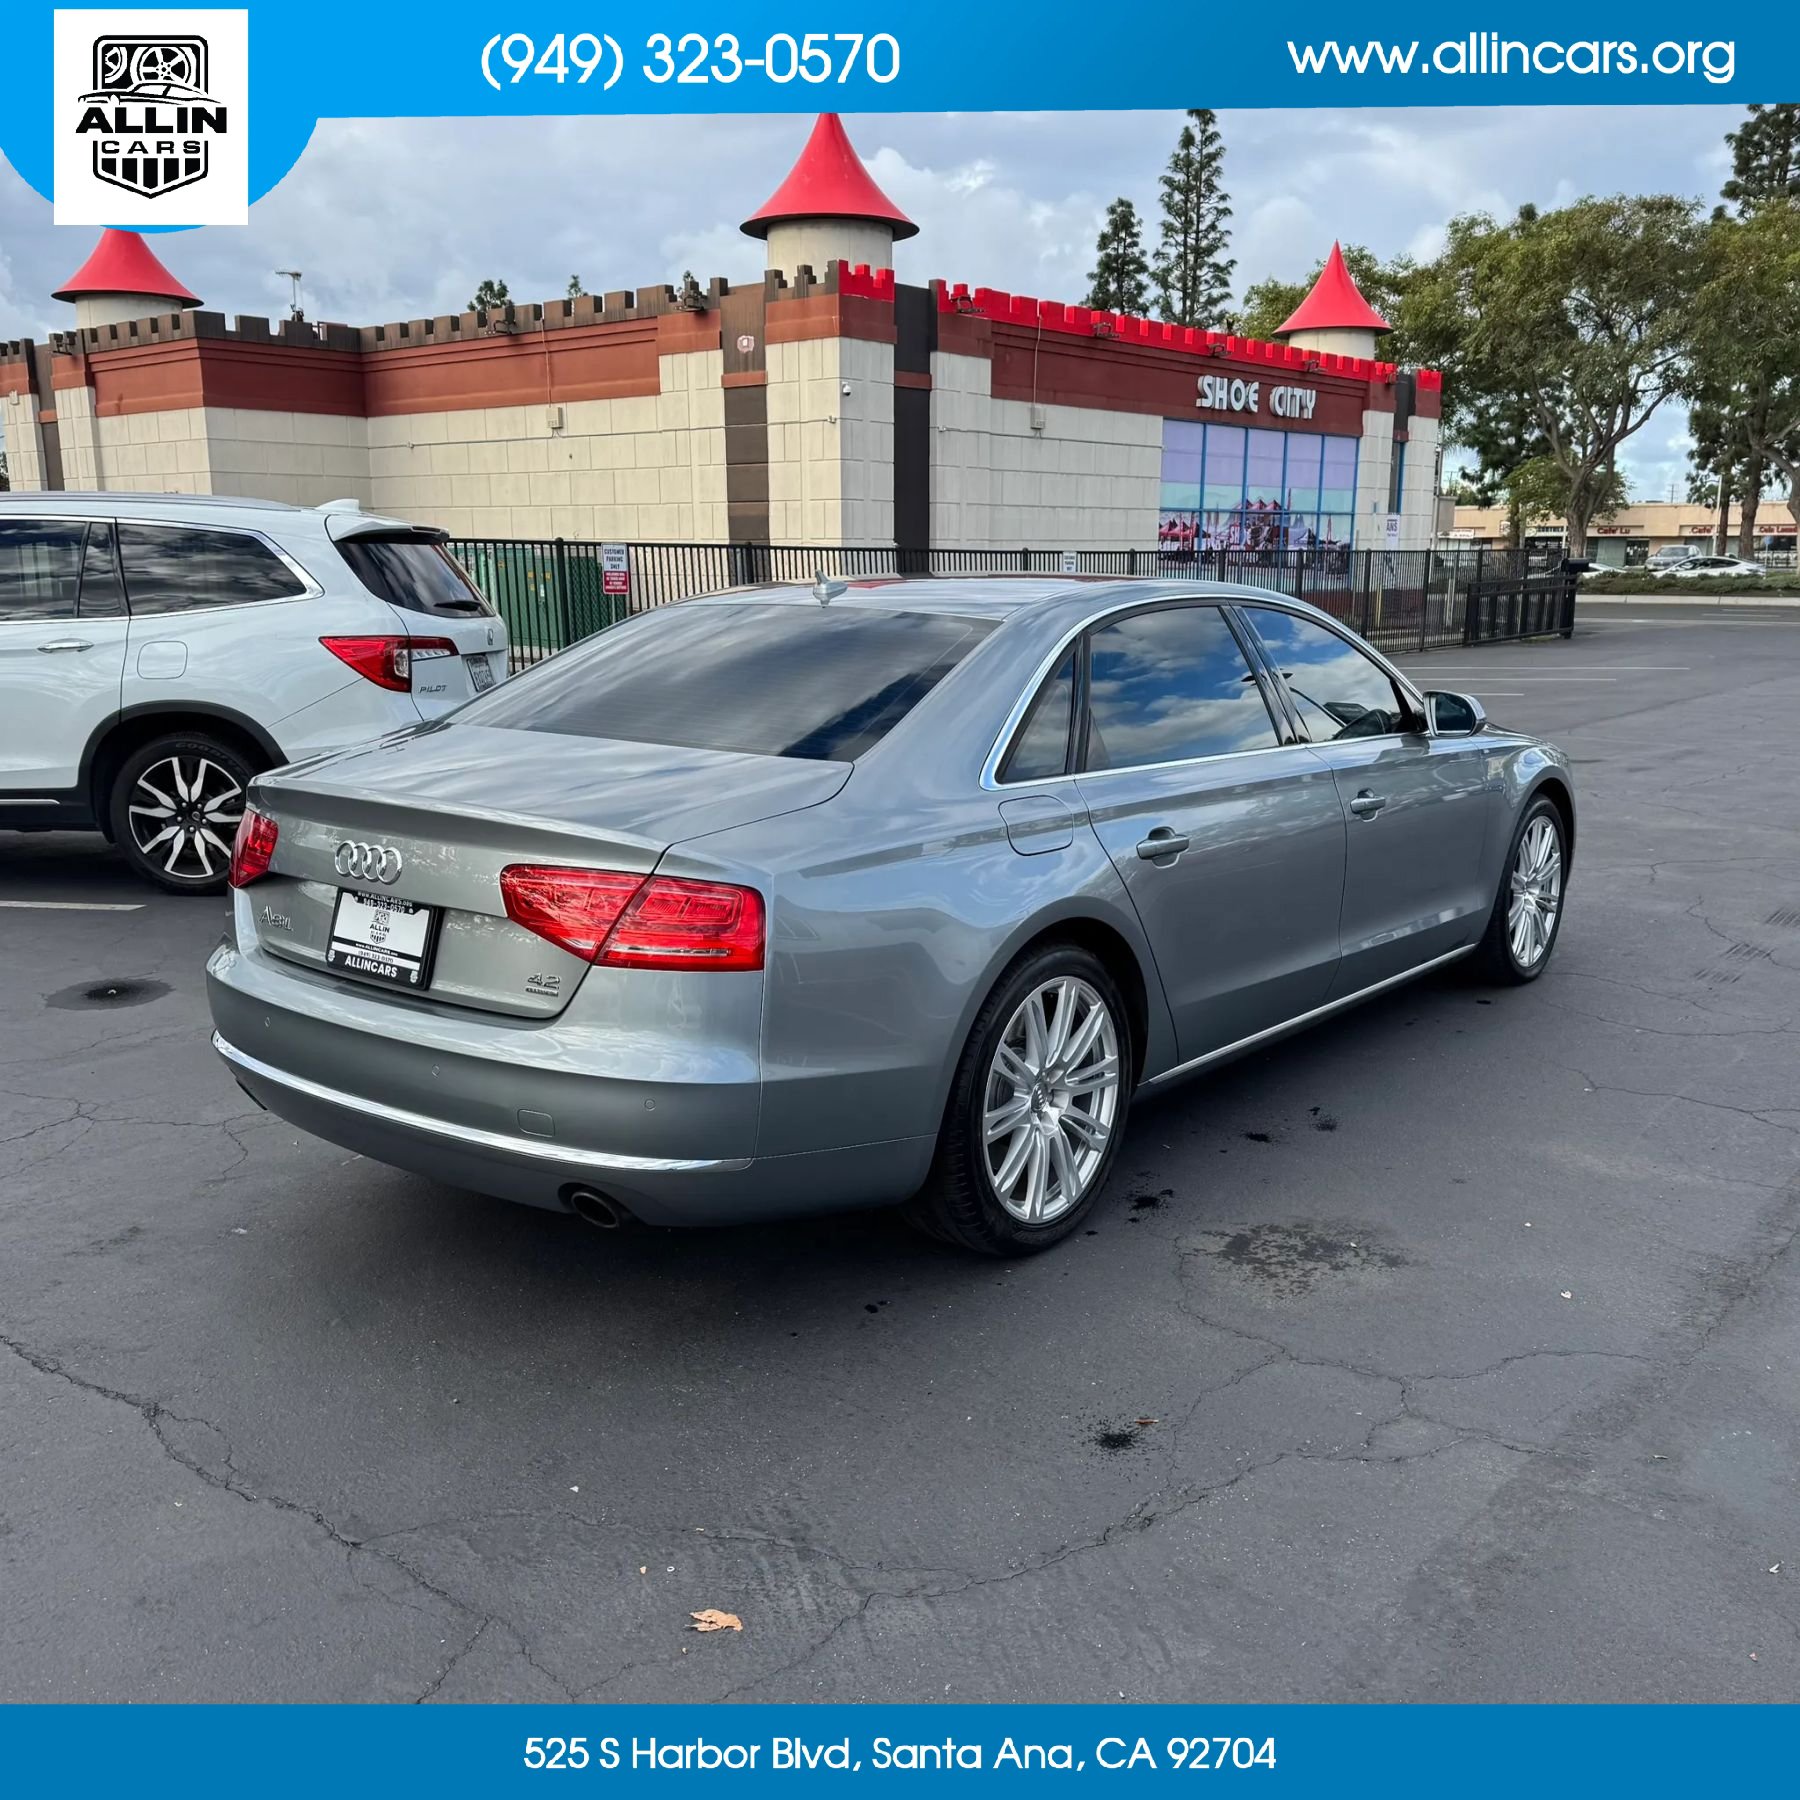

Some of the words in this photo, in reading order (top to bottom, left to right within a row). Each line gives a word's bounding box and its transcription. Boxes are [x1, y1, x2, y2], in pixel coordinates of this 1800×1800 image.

[1196, 374, 1260, 413] SHOE
[1269, 385, 1317, 420] CITY
[418, 684, 447, 694] PILOT
[369, 923, 390, 933] ALLIN
[344, 955, 398, 978] ALLINCARS
